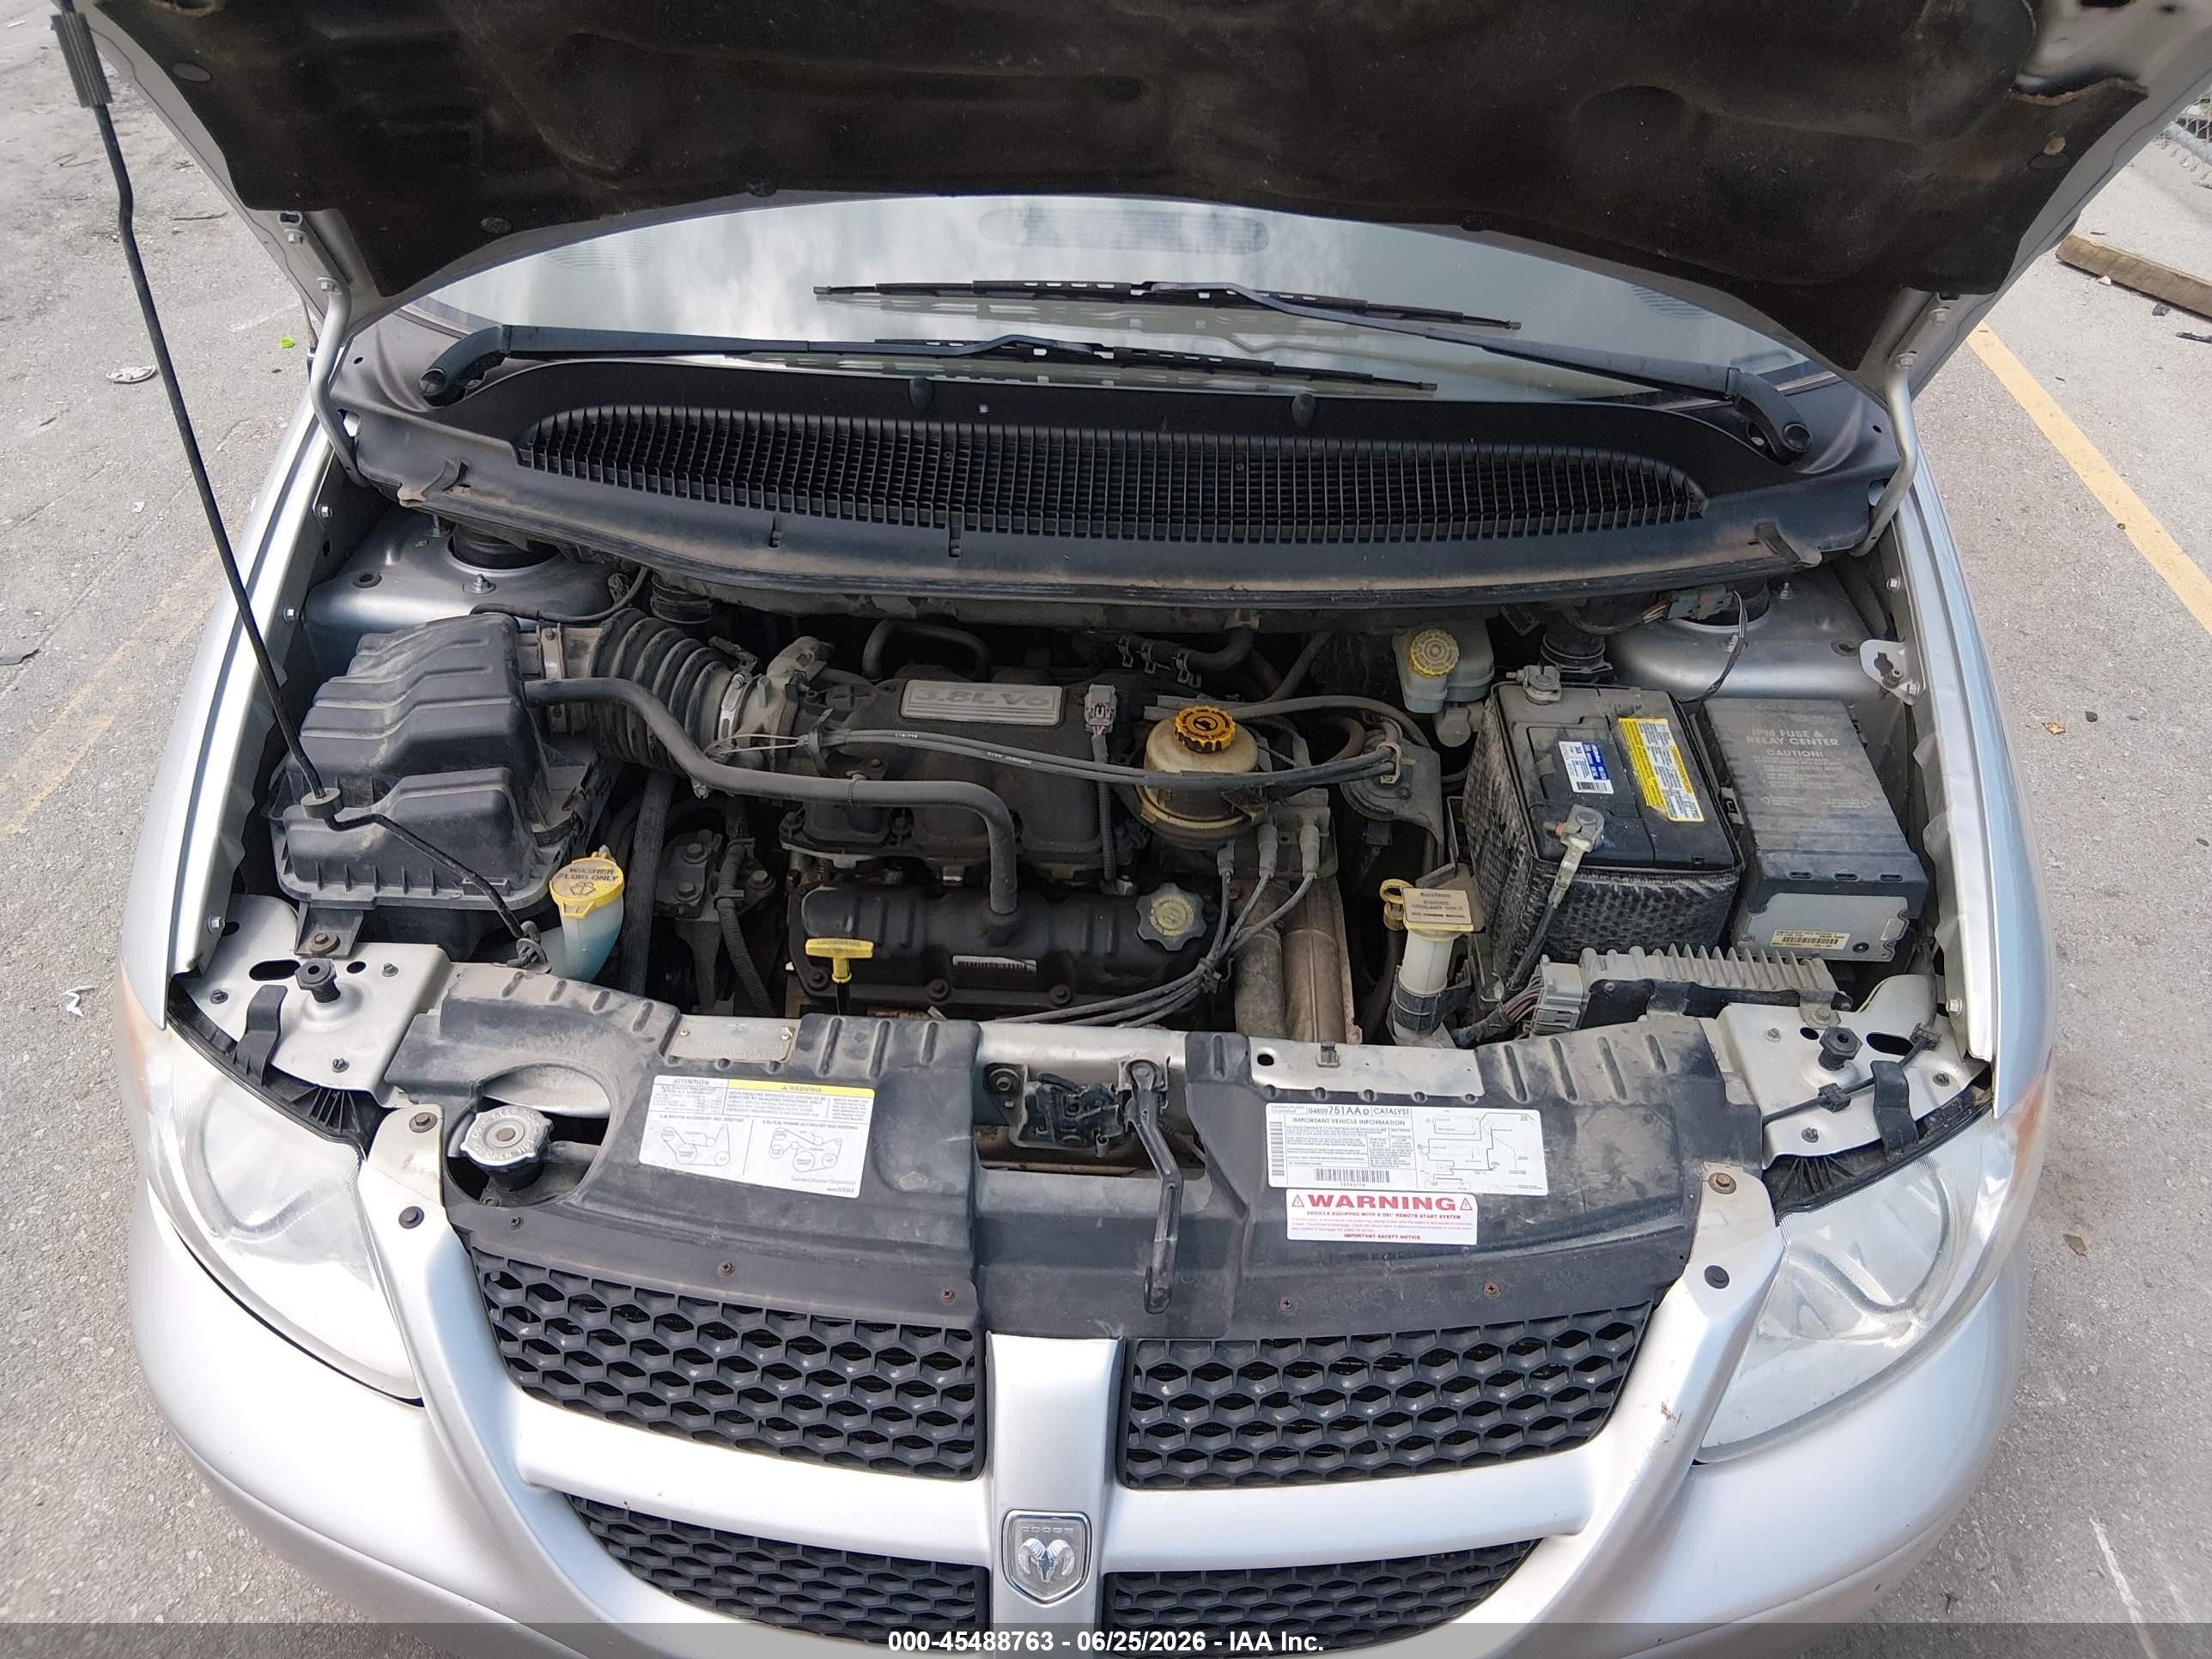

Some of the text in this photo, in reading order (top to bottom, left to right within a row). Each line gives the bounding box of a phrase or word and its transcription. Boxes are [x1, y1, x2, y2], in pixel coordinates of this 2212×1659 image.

[915, 689, 1050, 706] 3.8L V6
[1746, 736, 1839, 746] RELAY CENTER
[1374, 1107, 1410, 1115] CATALYST
[1308, 1194, 1455, 1211] WARNING
